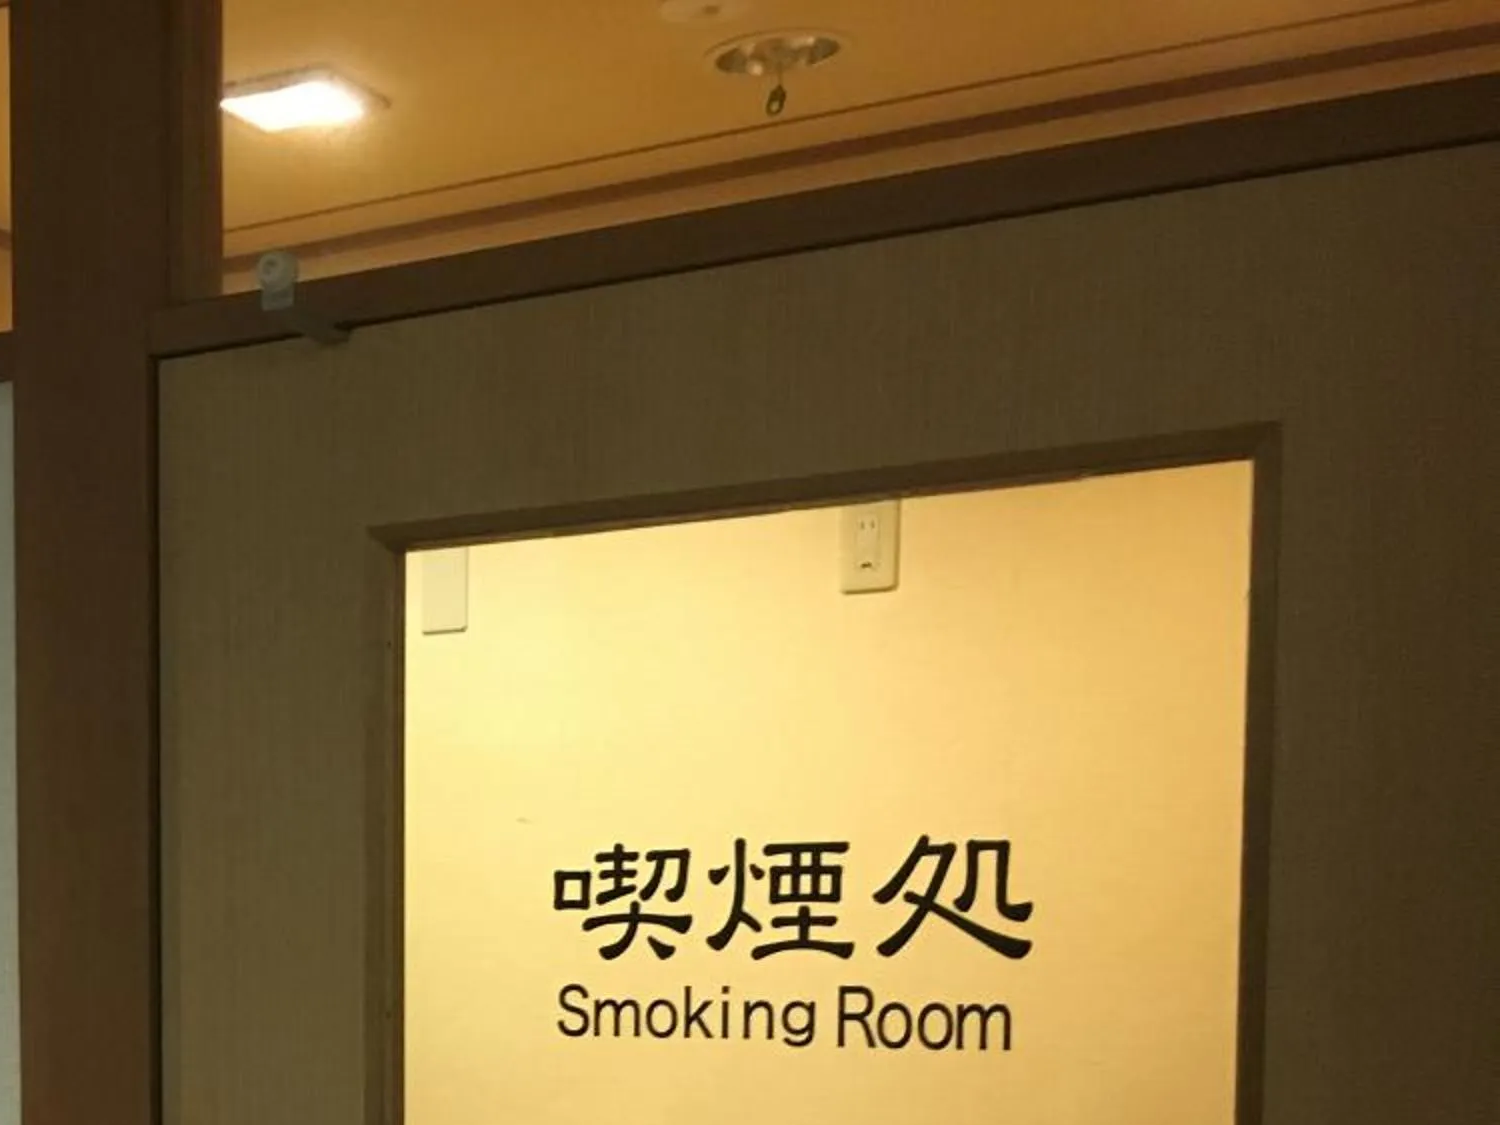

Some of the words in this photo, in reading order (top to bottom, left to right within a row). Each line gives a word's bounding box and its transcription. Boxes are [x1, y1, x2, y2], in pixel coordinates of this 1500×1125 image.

[553, 835, 1033, 961] 喫煙処
[557, 984, 816, 1047] Smoking
[837, 985, 1012, 1051] Room
